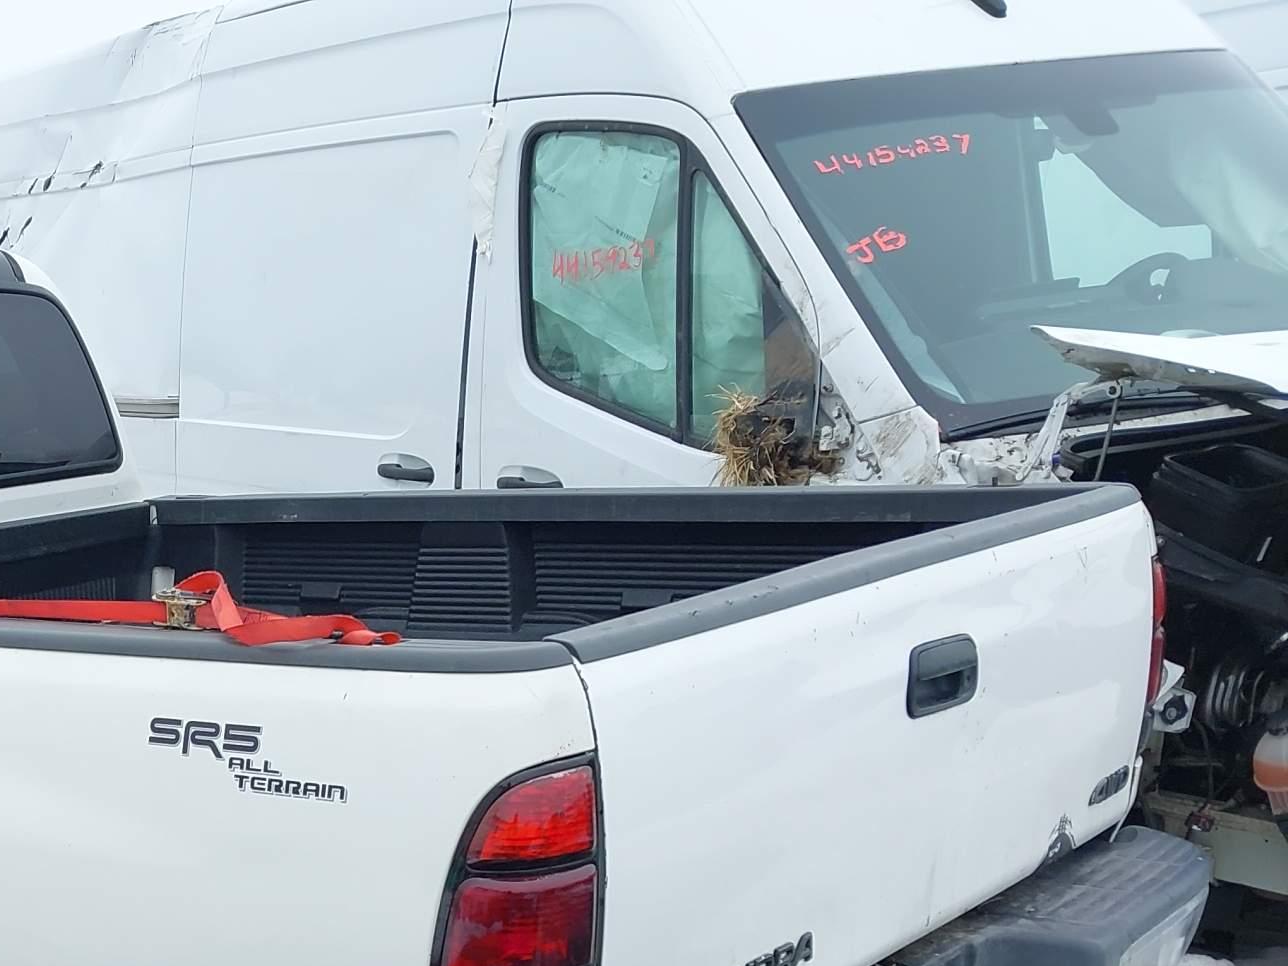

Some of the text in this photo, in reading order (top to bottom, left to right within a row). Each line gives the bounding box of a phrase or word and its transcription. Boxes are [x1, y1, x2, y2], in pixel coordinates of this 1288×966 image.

[813, 133, 970, 175] 44154237
[148, 717, 262, 761] SR5
[228, 757, 281, 776] ALL
[233, 774, 347, 803] TERRAIN
